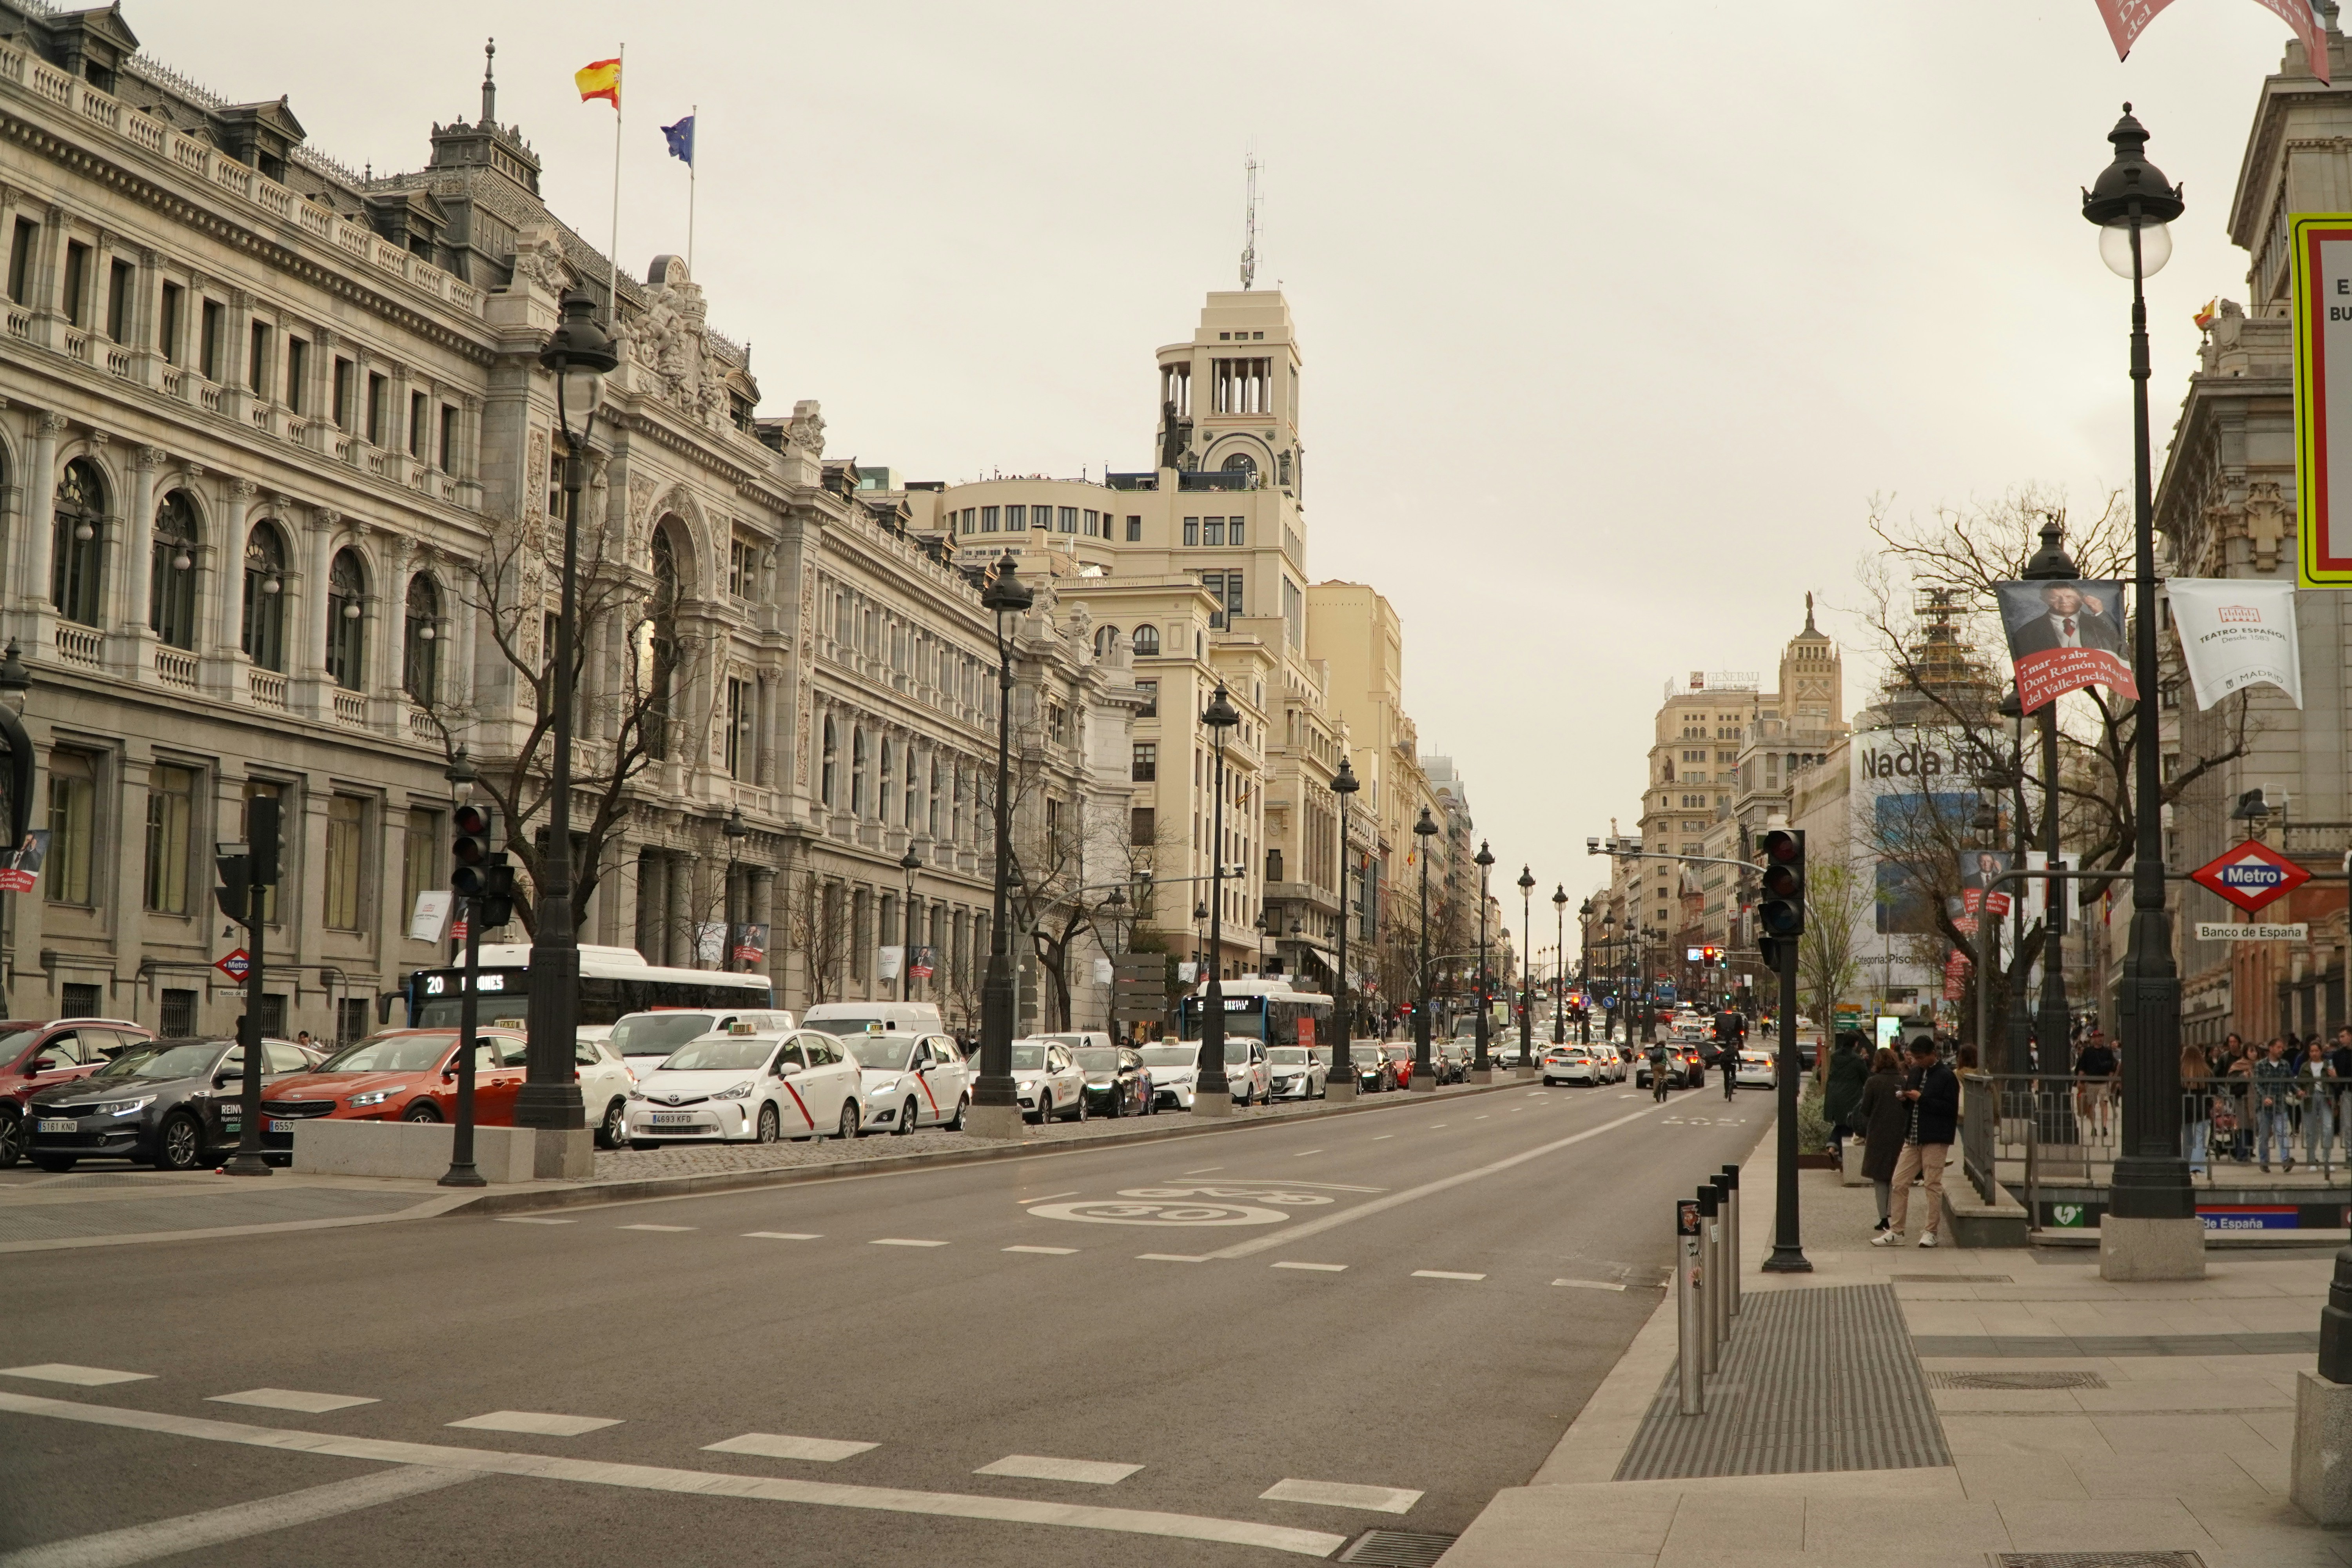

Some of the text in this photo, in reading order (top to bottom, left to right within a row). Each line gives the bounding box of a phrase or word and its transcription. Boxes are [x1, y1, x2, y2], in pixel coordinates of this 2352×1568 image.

[2127, 4, 2152, 40] del
[2337, 279, 2352, 294] E
[2200, 628, 2287, 644] TEATRO ESPAÑOL
[2222, 635, 2247, 644] Desde
[2029, 659, 2051, 675] mar
[2069, 650, 2089, 660] abr
[1707, 672, 1760, 682] GENERALI
[2024, 661, 2129, 692] Don Ramón María
[2239, 670, 2283, 684] MADRID
[2027, 671, 2113, 706] del Valle-Inclán
[1862, 743, 1941, 780] Nada
[2228, 867, 2277, 883] Metro
[2202, 927, 2301, 940] Banco de España
[427, 976, 444, 994] 20
[42, 1123, 58, 1131] 5161
[275, 1122, 294, 1131] 6557
[1086, 1205, 1228, 1220] 30
[2204, 1218, 2263, 1229] de España
